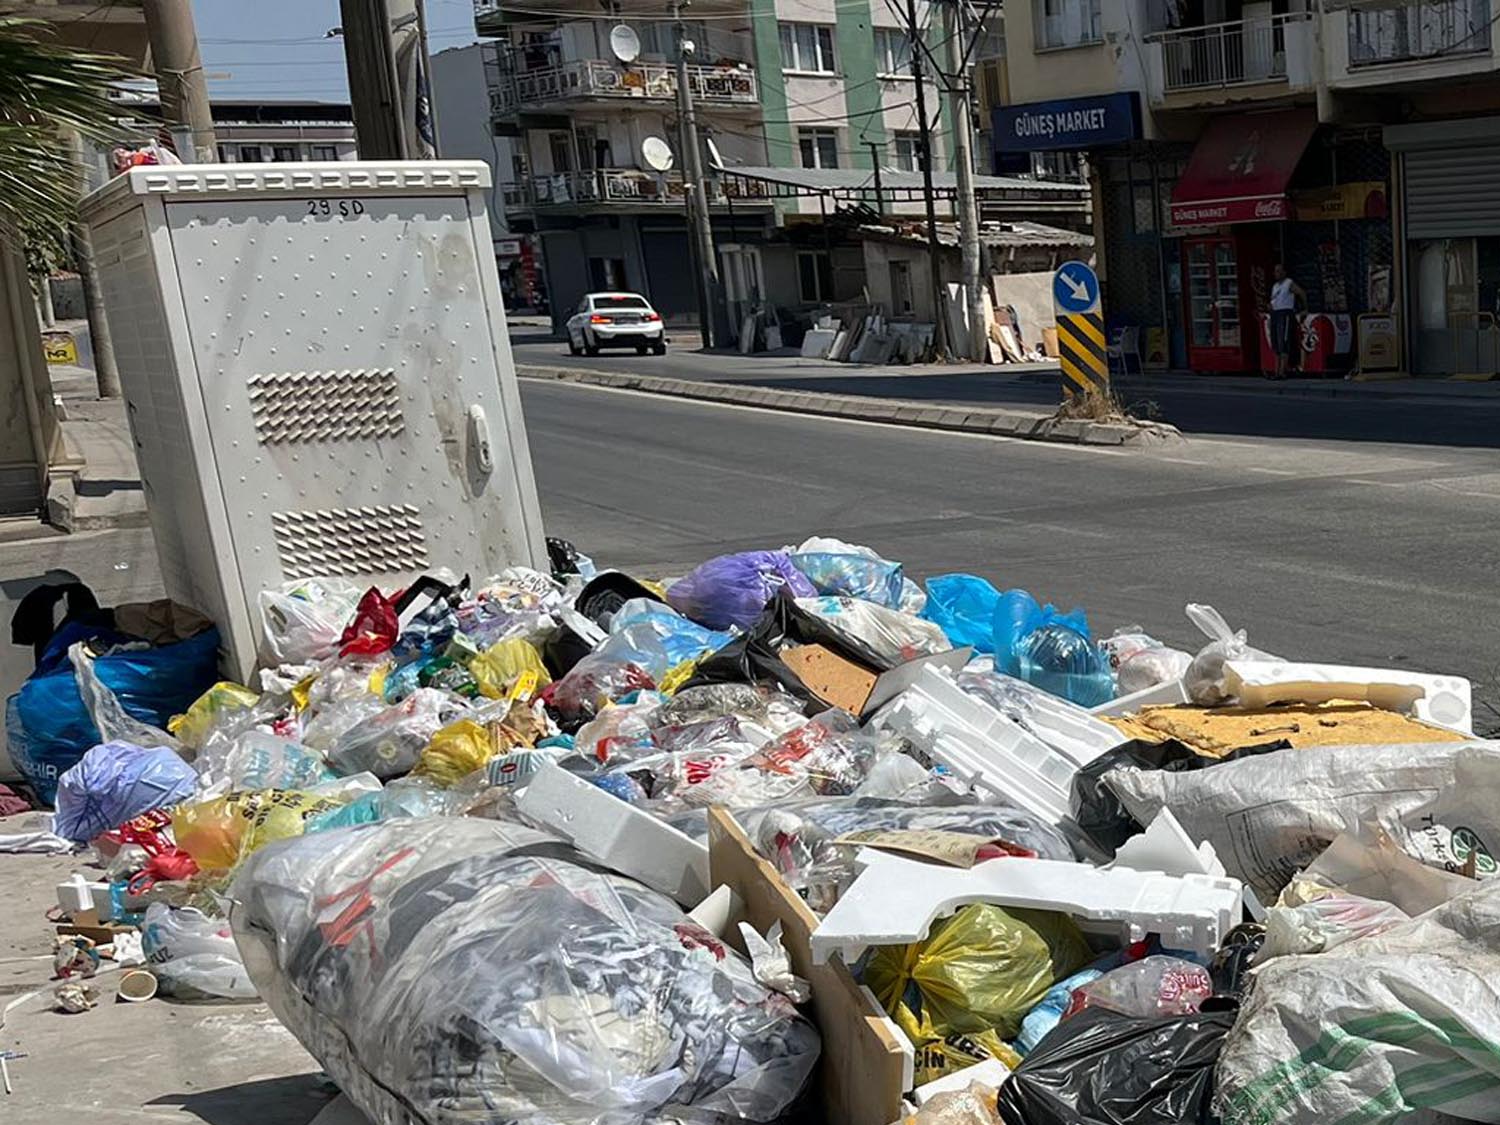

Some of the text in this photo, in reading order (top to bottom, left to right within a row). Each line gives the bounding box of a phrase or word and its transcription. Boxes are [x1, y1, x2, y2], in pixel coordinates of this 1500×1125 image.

[1015, 108, 1106, 138] GÜNEŞ MARKET
[307, 199, 330, 215] 29
